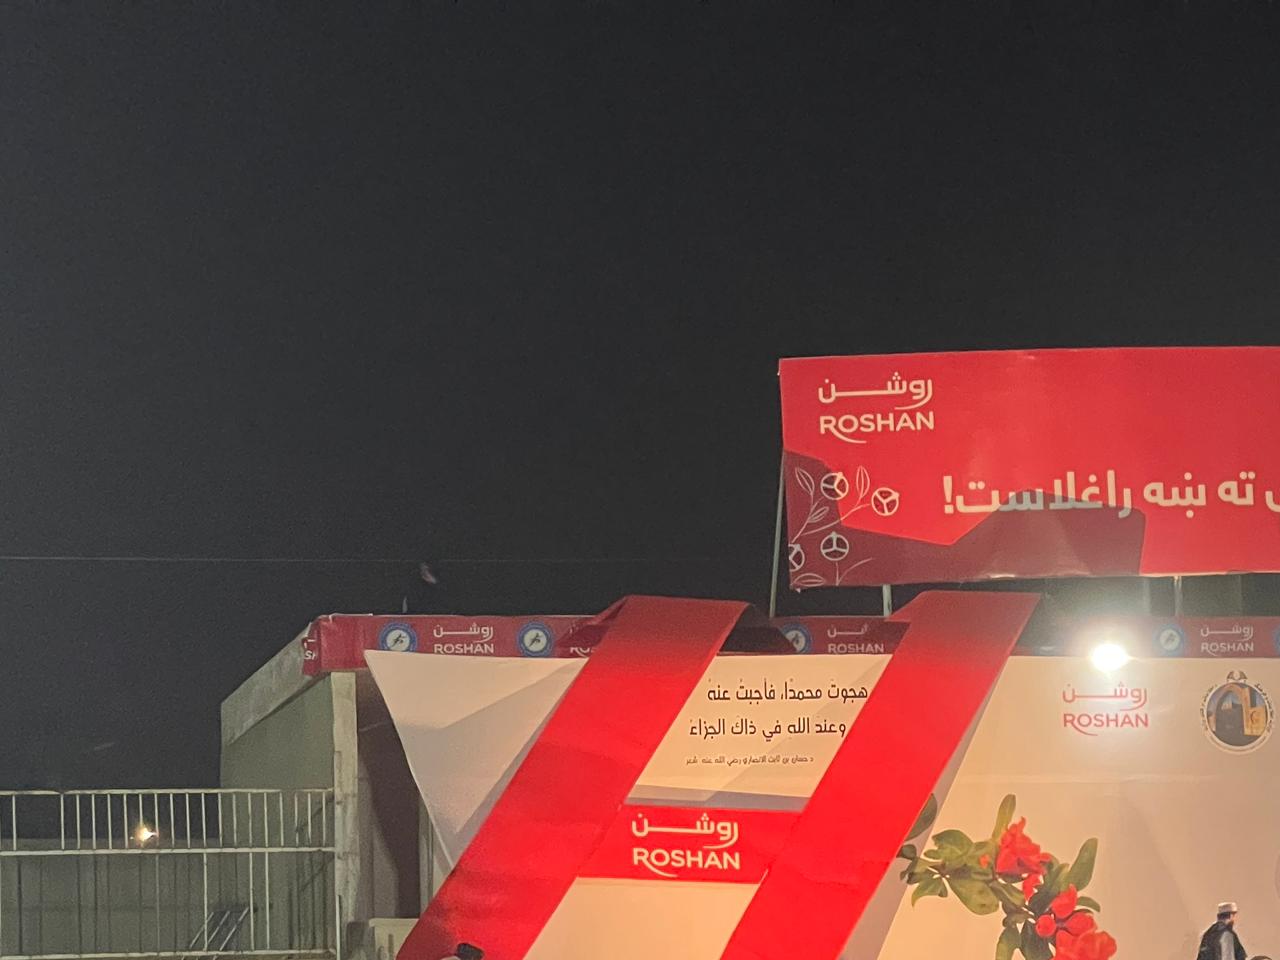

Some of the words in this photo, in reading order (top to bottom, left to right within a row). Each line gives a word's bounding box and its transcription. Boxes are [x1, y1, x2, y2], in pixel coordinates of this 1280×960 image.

[818, 371, 933, 410] روشن
[819, 411, 935, 443] ROSHAN
[942, 469, 1133, 519] راغلاست!
[1142, 471, 1207, 519] ښه
[1217, 470, 1256, 506] ته
[433, 622, 494, 643] روشن
[827, 642, 885, 654] ROSHAN
[1200, 624, 1254, 642] روشن
[433, 643, 495, 654] ROSHAN
[1200, 642, 1254, 657] ROSHAN
[1062, 681, 1148, 712] روشن
[762, 719, 782, 742] في
[1062, 713, 1150, 737] ROSHAN
[631, 812, 739, 849] روشن
[632, 847, 741, 878] ROSHAN
